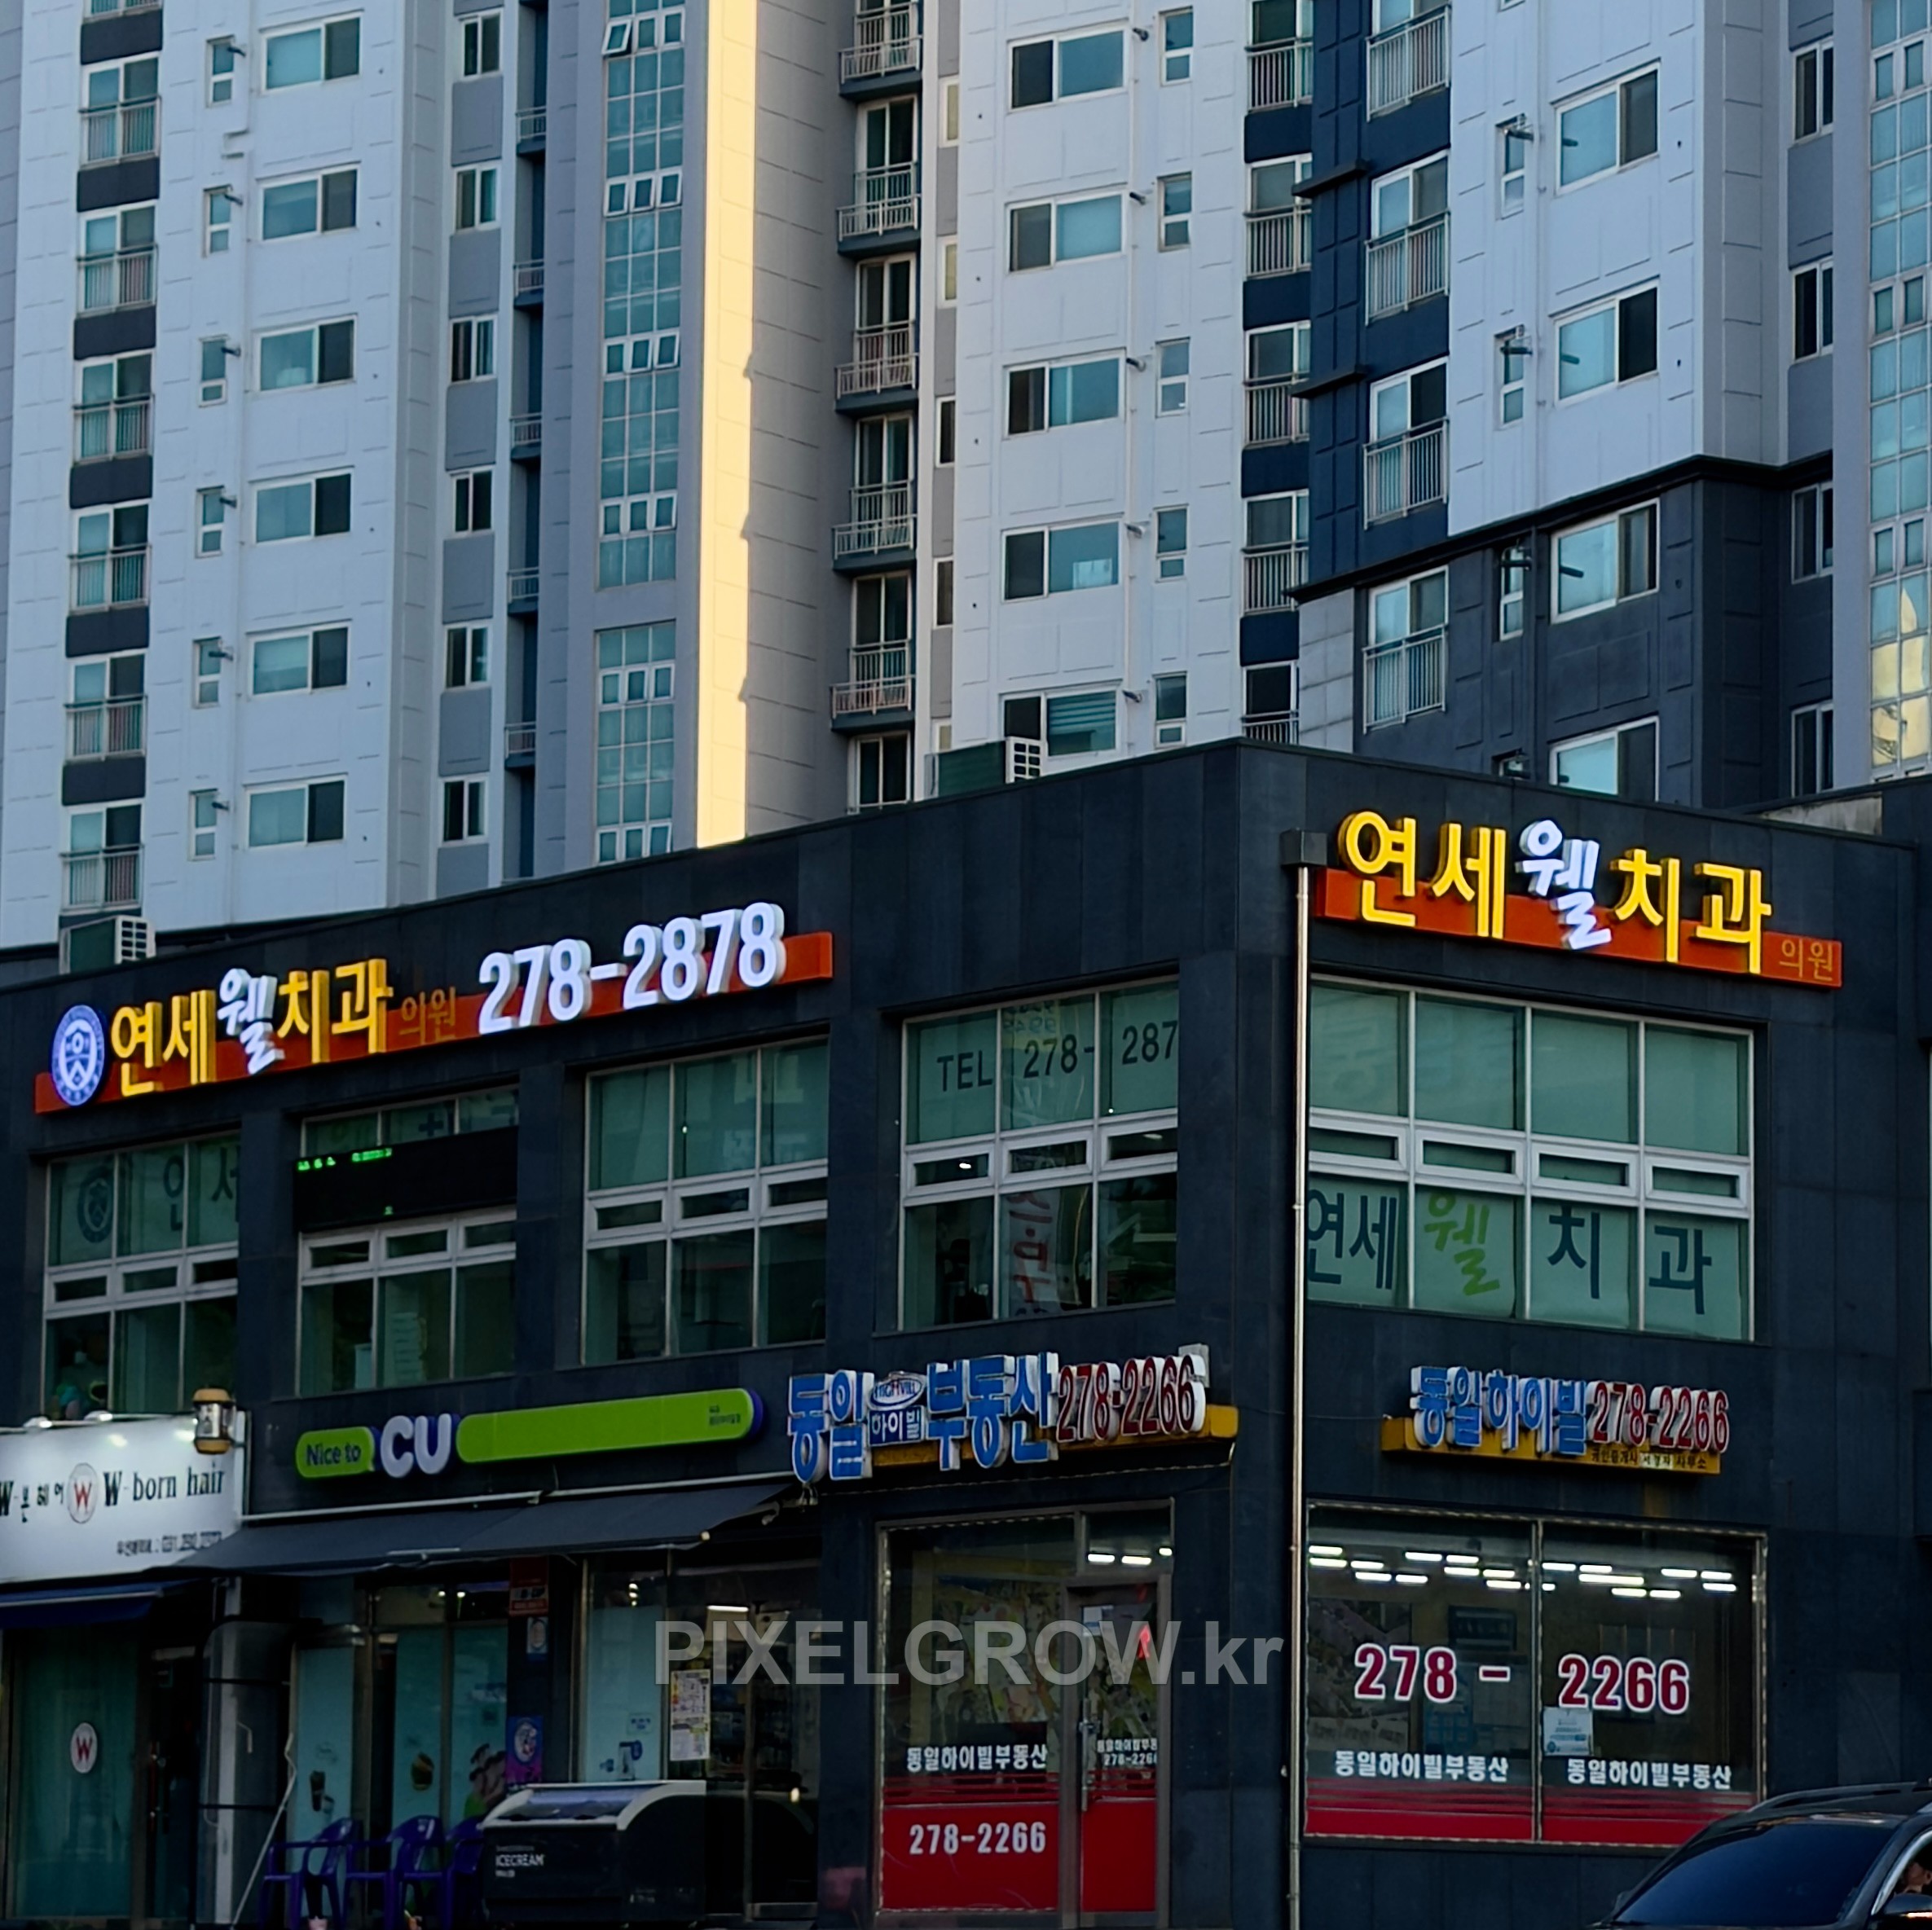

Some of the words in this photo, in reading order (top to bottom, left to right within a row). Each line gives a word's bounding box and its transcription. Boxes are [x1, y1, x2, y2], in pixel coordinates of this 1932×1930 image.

[1337, 811, 1771, 975] 연세웰치과
[1779, 937, 1833, 982] 의원
[111, 957, 394, 1097] 연세웰치과
[398, 987, 457, 1045] 의원
[478, 902, 786, 1035] 278-2878
[937, 1049, 994, 1092] TEL
[787, 1369, 874, 1483] 동일
[871, 1411, 921, 1440] 하이빌
[926, 1351, 1059, 1471] 부동산
[1058, 1352, 1207, 1443] 278-2266
[1410, 1365, 1587, 1456] 동일하이빌
[1587, 1379, 1730, 1454] 278-2266
[306, 1444, 341, 1466] Nice
[344, 1445, 362, 1462] to
[380, 1413, 455, 1479] CU
[73, 1482, 92, 1516] W
[103, 1470, 177, 1507] W-born
[187, 1465, 226, 1497] hair
[75, 1736, 94, 1762] W
[907, 1743, 1048, 1773] 동일하이빌부동산
[1336, 1750, 1508, 1783] 동일하이빌부동산
[1567, 1758, 1732, 1790] 동일하이빌부동산
[909, 1822, 1047, 1855] 278-2266
[495, 1853, 545, 1866] ICECREAM
